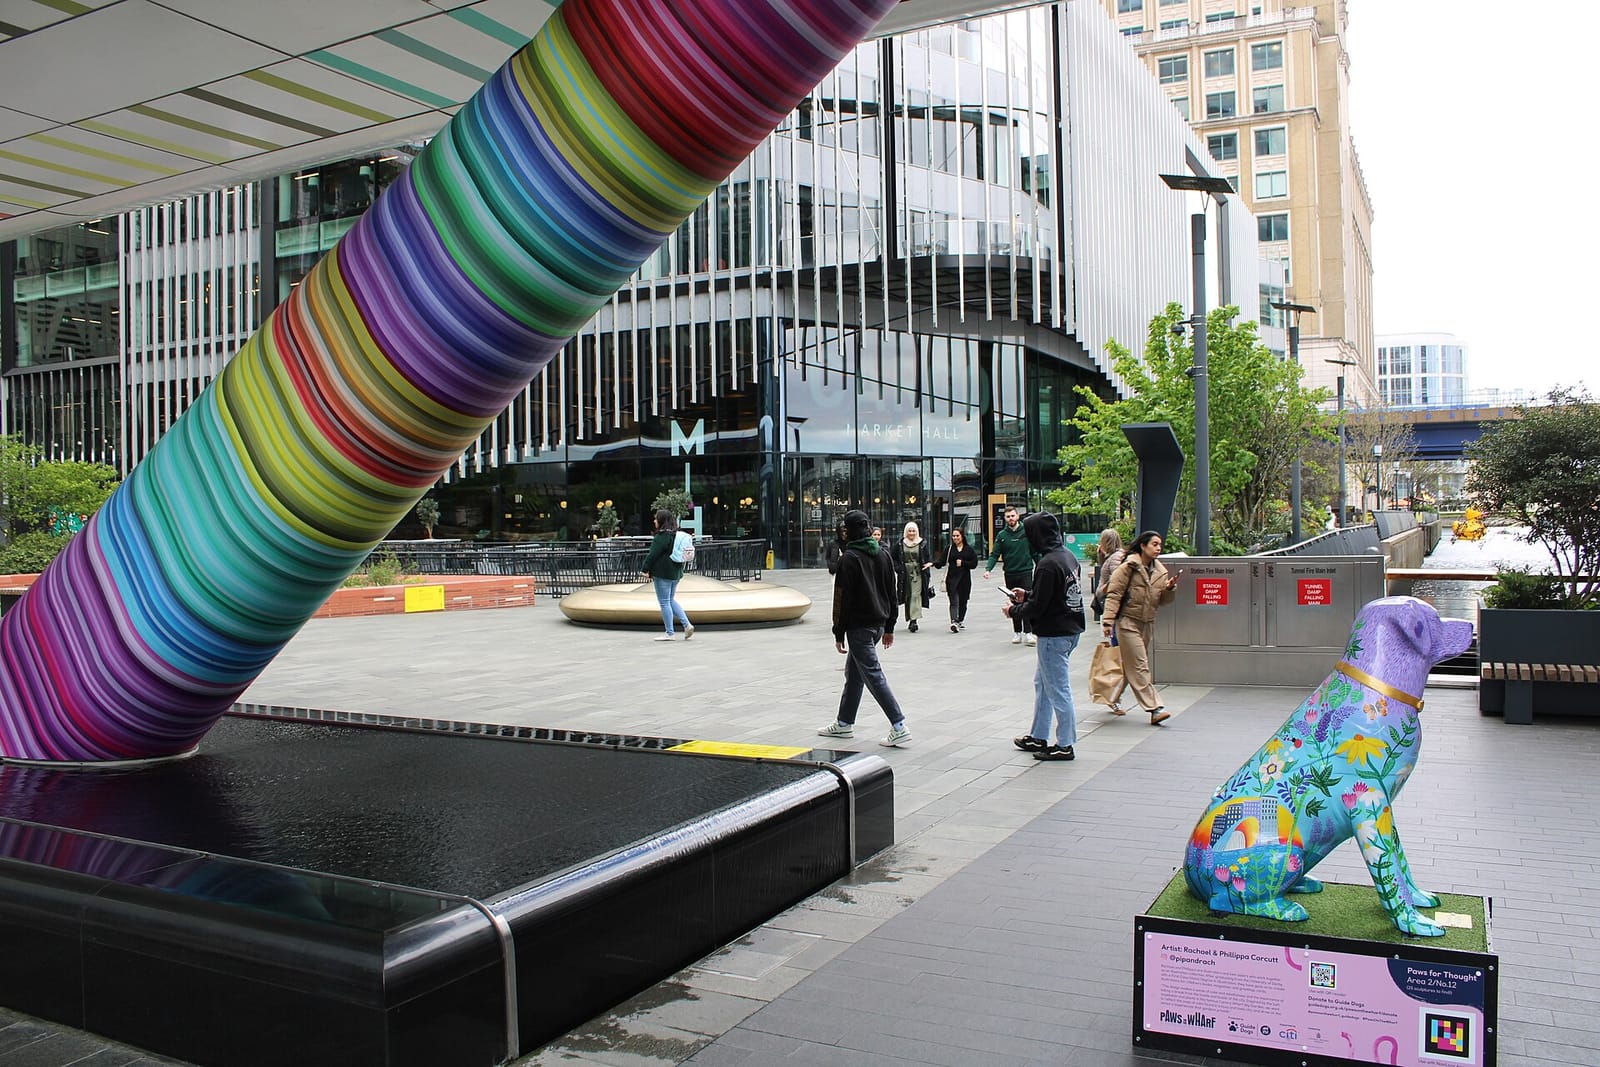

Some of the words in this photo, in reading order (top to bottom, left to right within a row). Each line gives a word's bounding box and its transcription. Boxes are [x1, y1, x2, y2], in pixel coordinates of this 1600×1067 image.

[671, 418, 704, 456] M
[846, 423, 913, 438] ARKET
[922, 426, 960, 440] HALL
[1161, 944, 1183, 953] Artist:
[1183, 946, 1212, 957] Rachael
[1219, 950, 1250, 961] Phillippa
[1250, 953, 1279, 963] Corcutt
[1169, 954, 1216, 966] @pipandrach
[1406, 976, 1426, 985] Area
[1427, 978, 1457, 989] 2/No.12
[1407, 967, 1428, 976] Paws
[1429, 969, 1442, 977] for
[1443, 971, 1477, 982] Thought
[1160, 1009, 1183, 1024] PAWS
[1187, 1012, 1217, 1029] WHARF
[1279, 1029, 1297, 1040] citi
